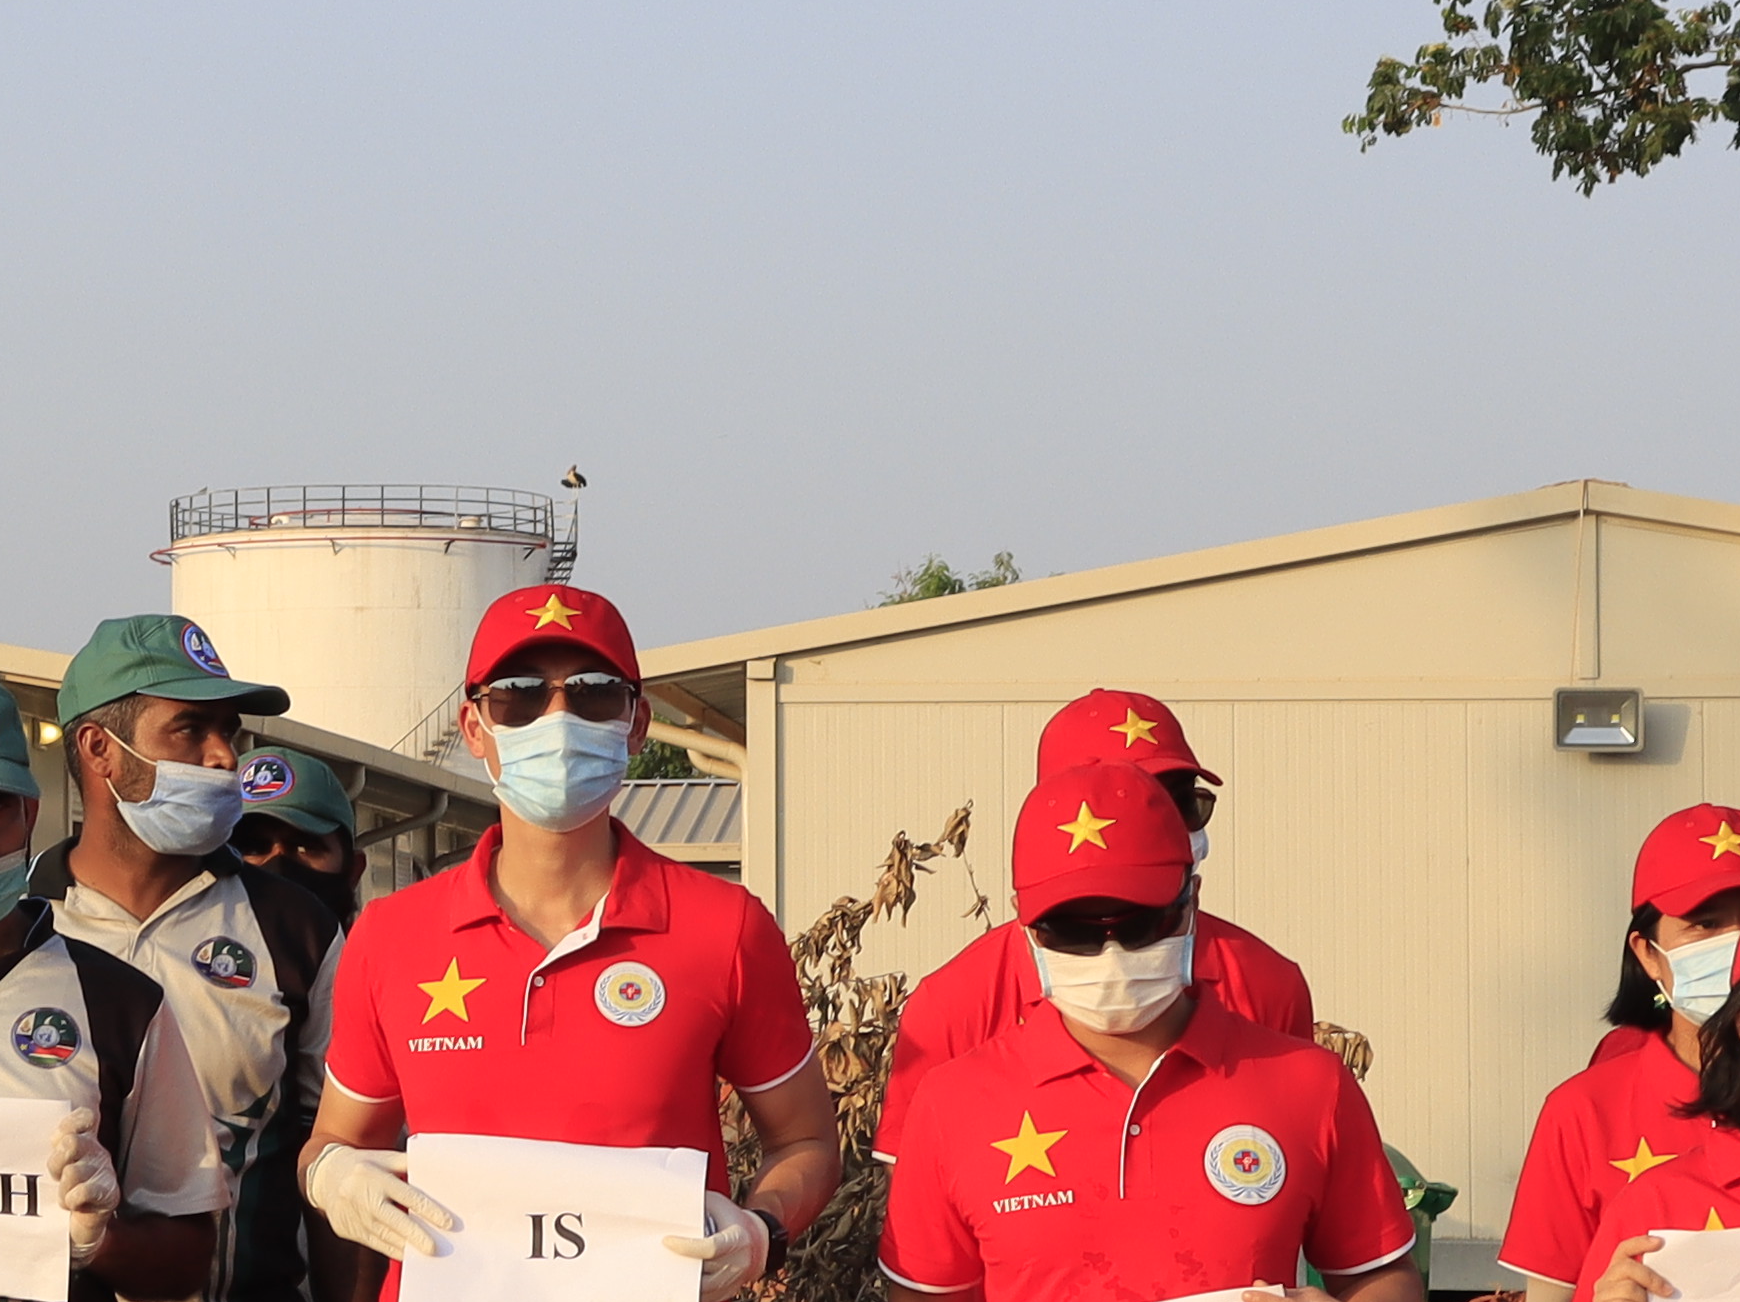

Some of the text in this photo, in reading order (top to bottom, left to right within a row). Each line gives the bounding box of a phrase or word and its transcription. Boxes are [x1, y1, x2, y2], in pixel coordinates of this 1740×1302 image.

[408, 1035, 483, 1052] VIETNAM
[992, 1190, 1074, 1214] VIETNAM
[528, 1212, 586, 1260] IS
